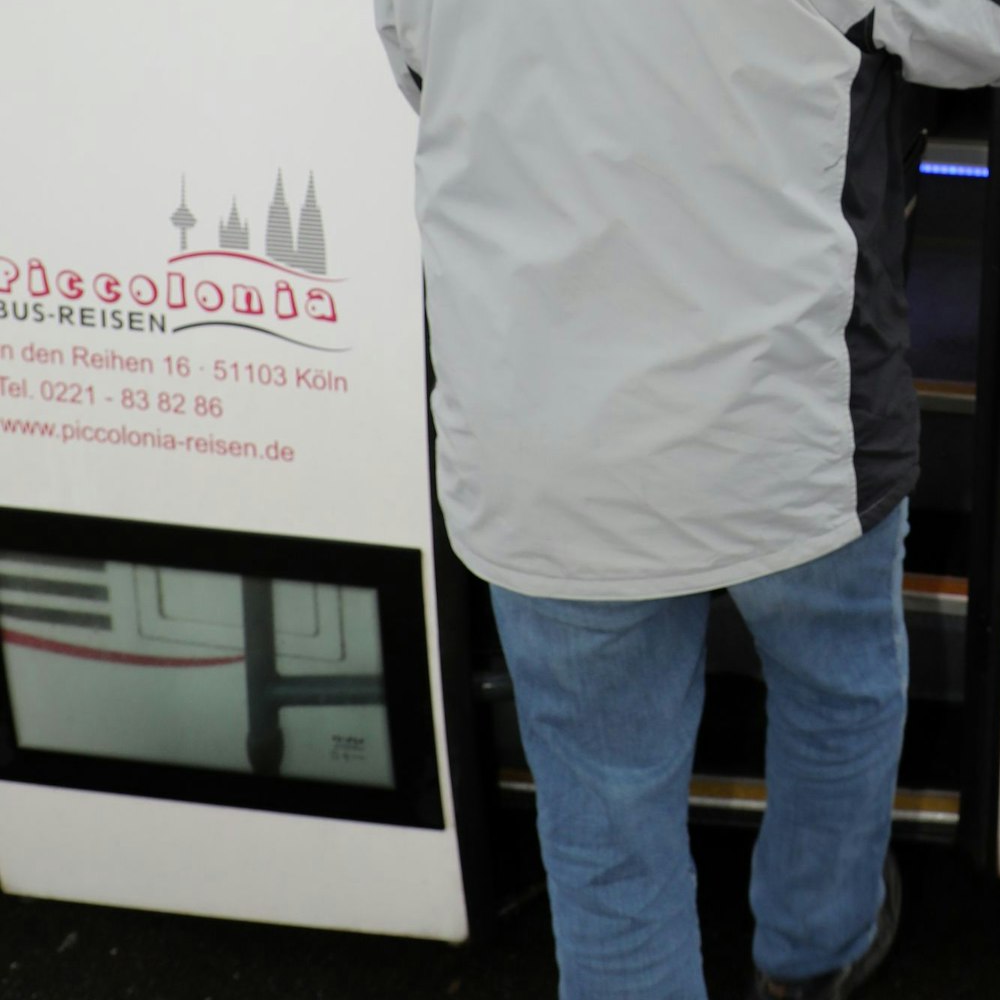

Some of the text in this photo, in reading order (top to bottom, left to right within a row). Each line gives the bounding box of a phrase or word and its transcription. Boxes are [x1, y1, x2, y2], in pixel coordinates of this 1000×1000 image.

[0, 255, 338, 323] Piccolonia
[0, 299, 166, 333] BUS-REISEN
[21, 343, 64, 365] den
[71, 345, 154, 374] Reihen
[163, 355, 191, 378] 16
[213, 358, 288, 387] 51103
[295, 367, 348, 393] Köln
[0, 375, 34, 399] Tel.
[40, 379, 96, 405] 0221
[121, 387, 150, 411] 83
[157, 391, 186, 415] 82
[194, 395, 224, 419] 86
[0, 417, 295, 463] www.piccolonia-reisen.de
